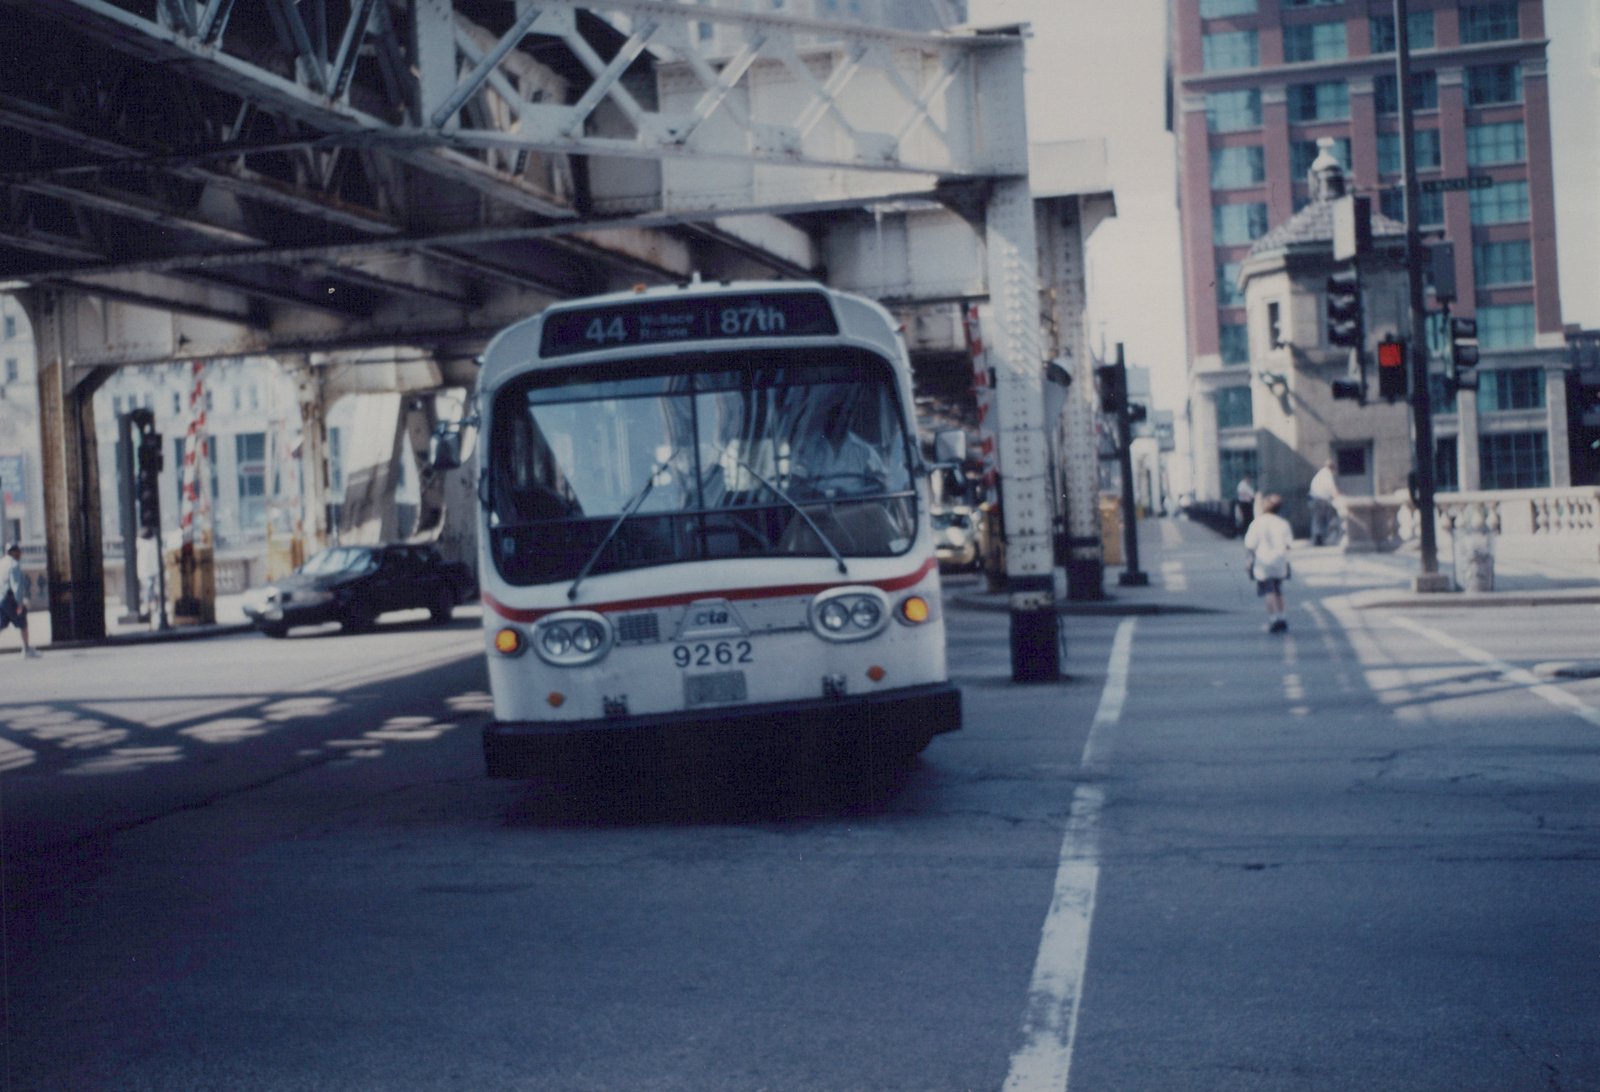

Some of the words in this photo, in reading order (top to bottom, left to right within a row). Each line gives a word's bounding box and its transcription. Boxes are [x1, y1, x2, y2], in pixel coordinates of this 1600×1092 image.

[585, 317, 627, 342] 44
[719, 307, 787, 335] 87th
[696, 609, 728, 625] cta
[673, 640, 754, 668] 9262
